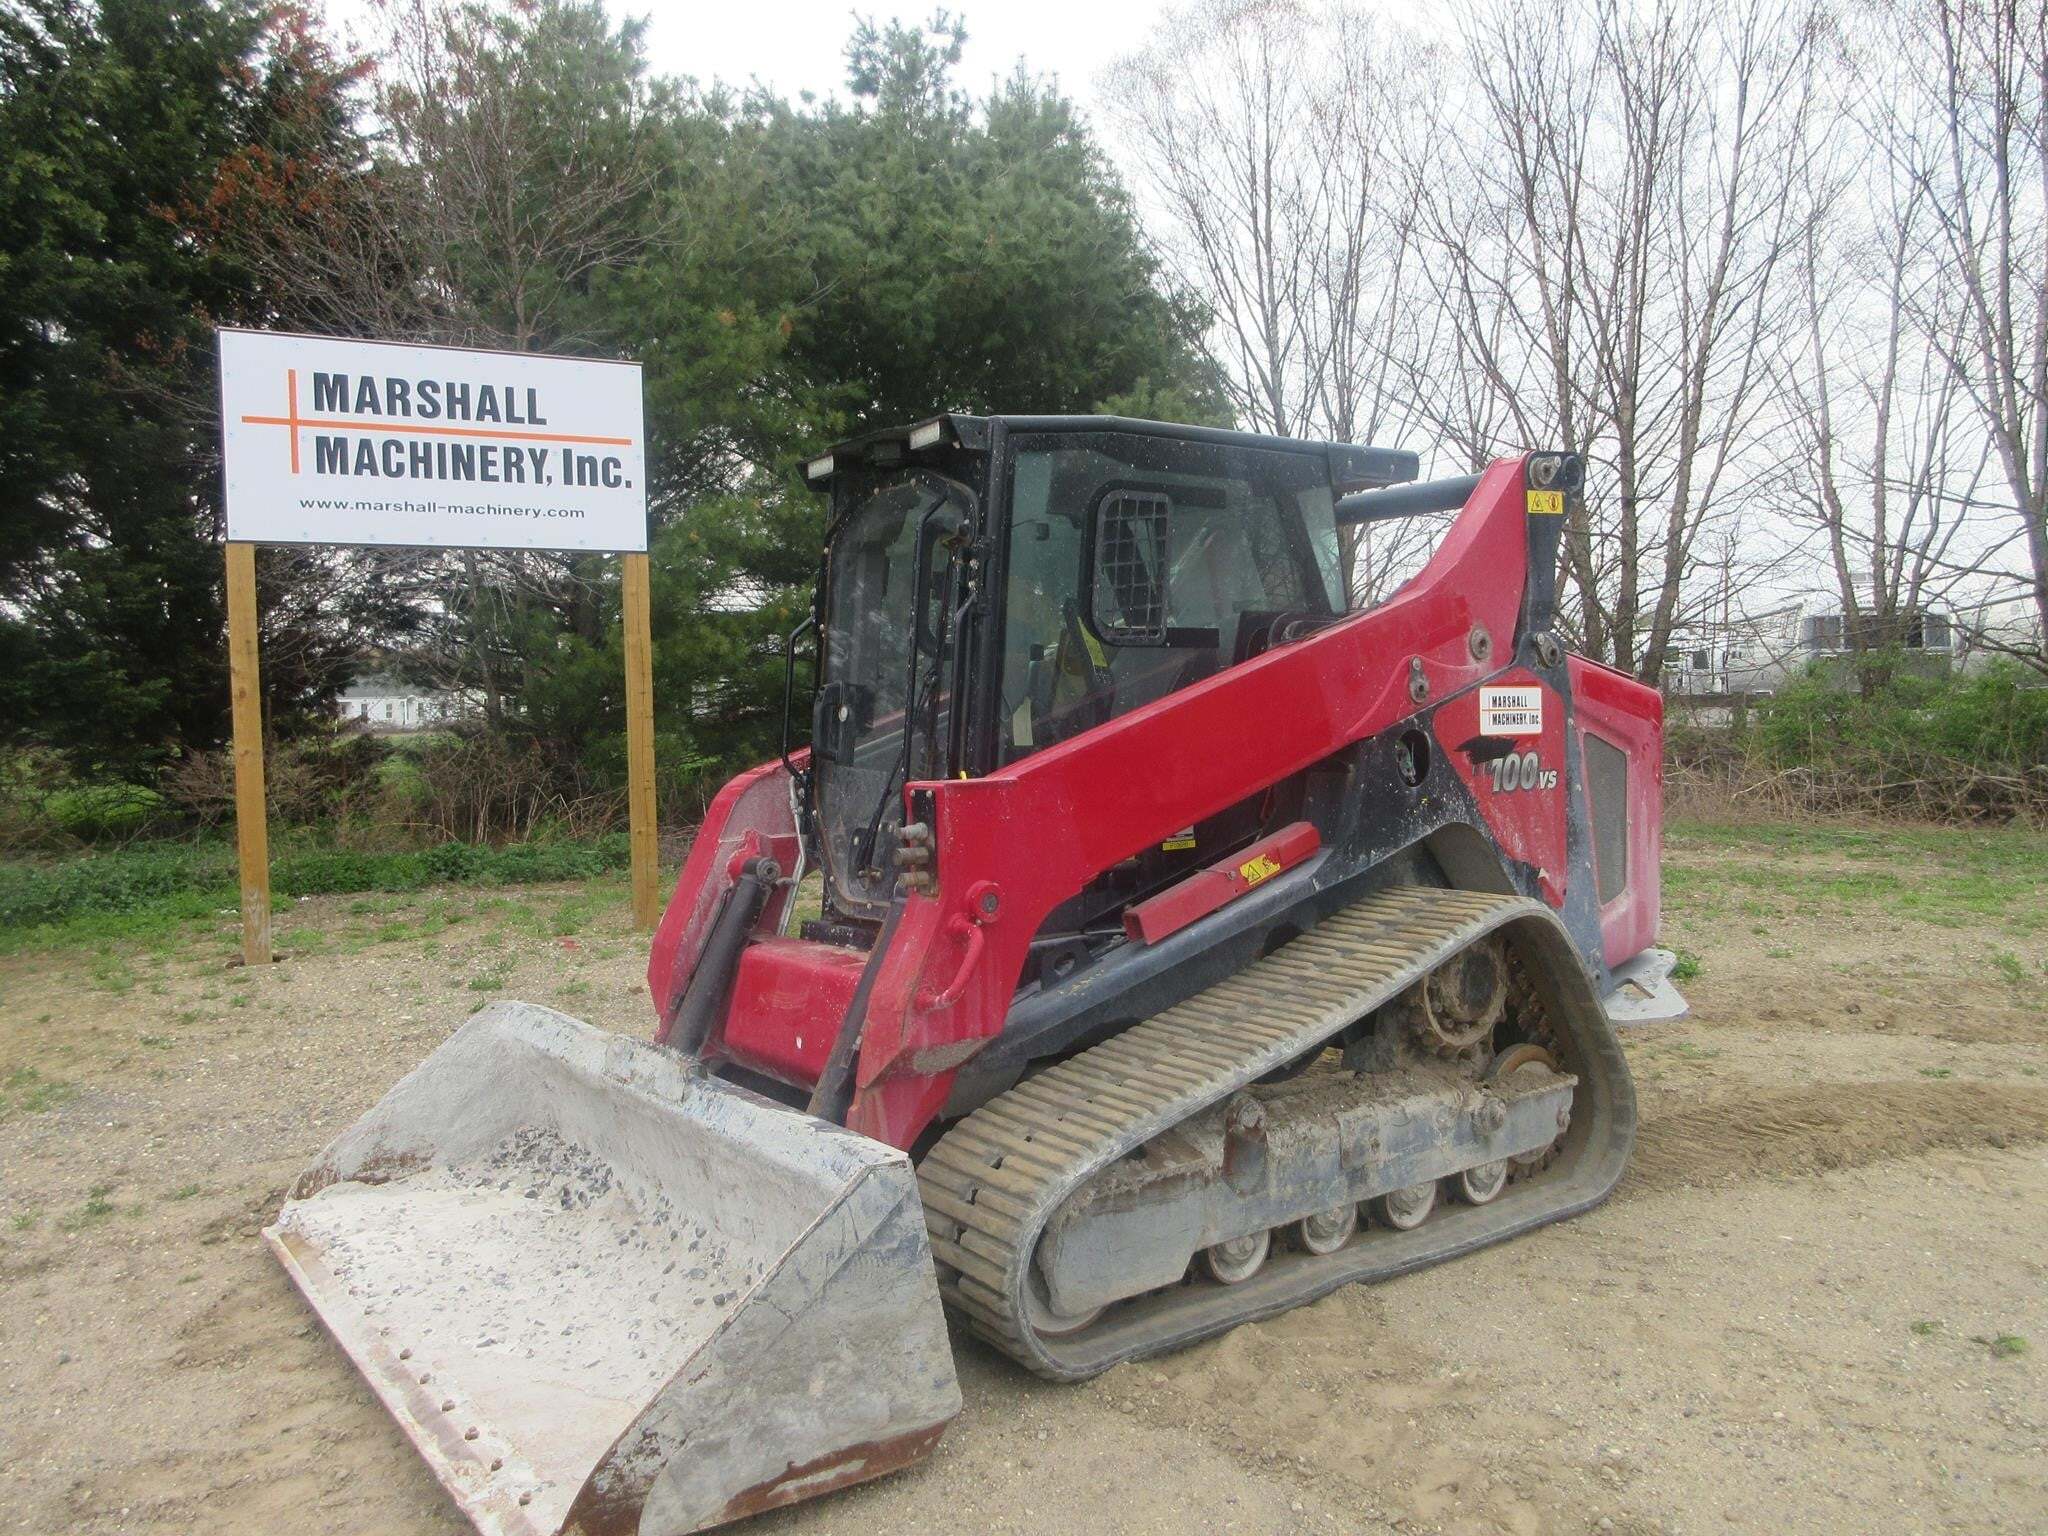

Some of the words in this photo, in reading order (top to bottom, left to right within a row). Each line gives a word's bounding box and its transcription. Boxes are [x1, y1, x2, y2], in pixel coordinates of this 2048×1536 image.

[313, 372, 547, 425] MARSHALL
[315, 435, 553, 486] MACHINERY,
[562, 448, 632, 488] Inc.
[300, 498, 585, 518] www.marshall-machinery.com
[1491, 695, 1528, 708] MARSHALL
